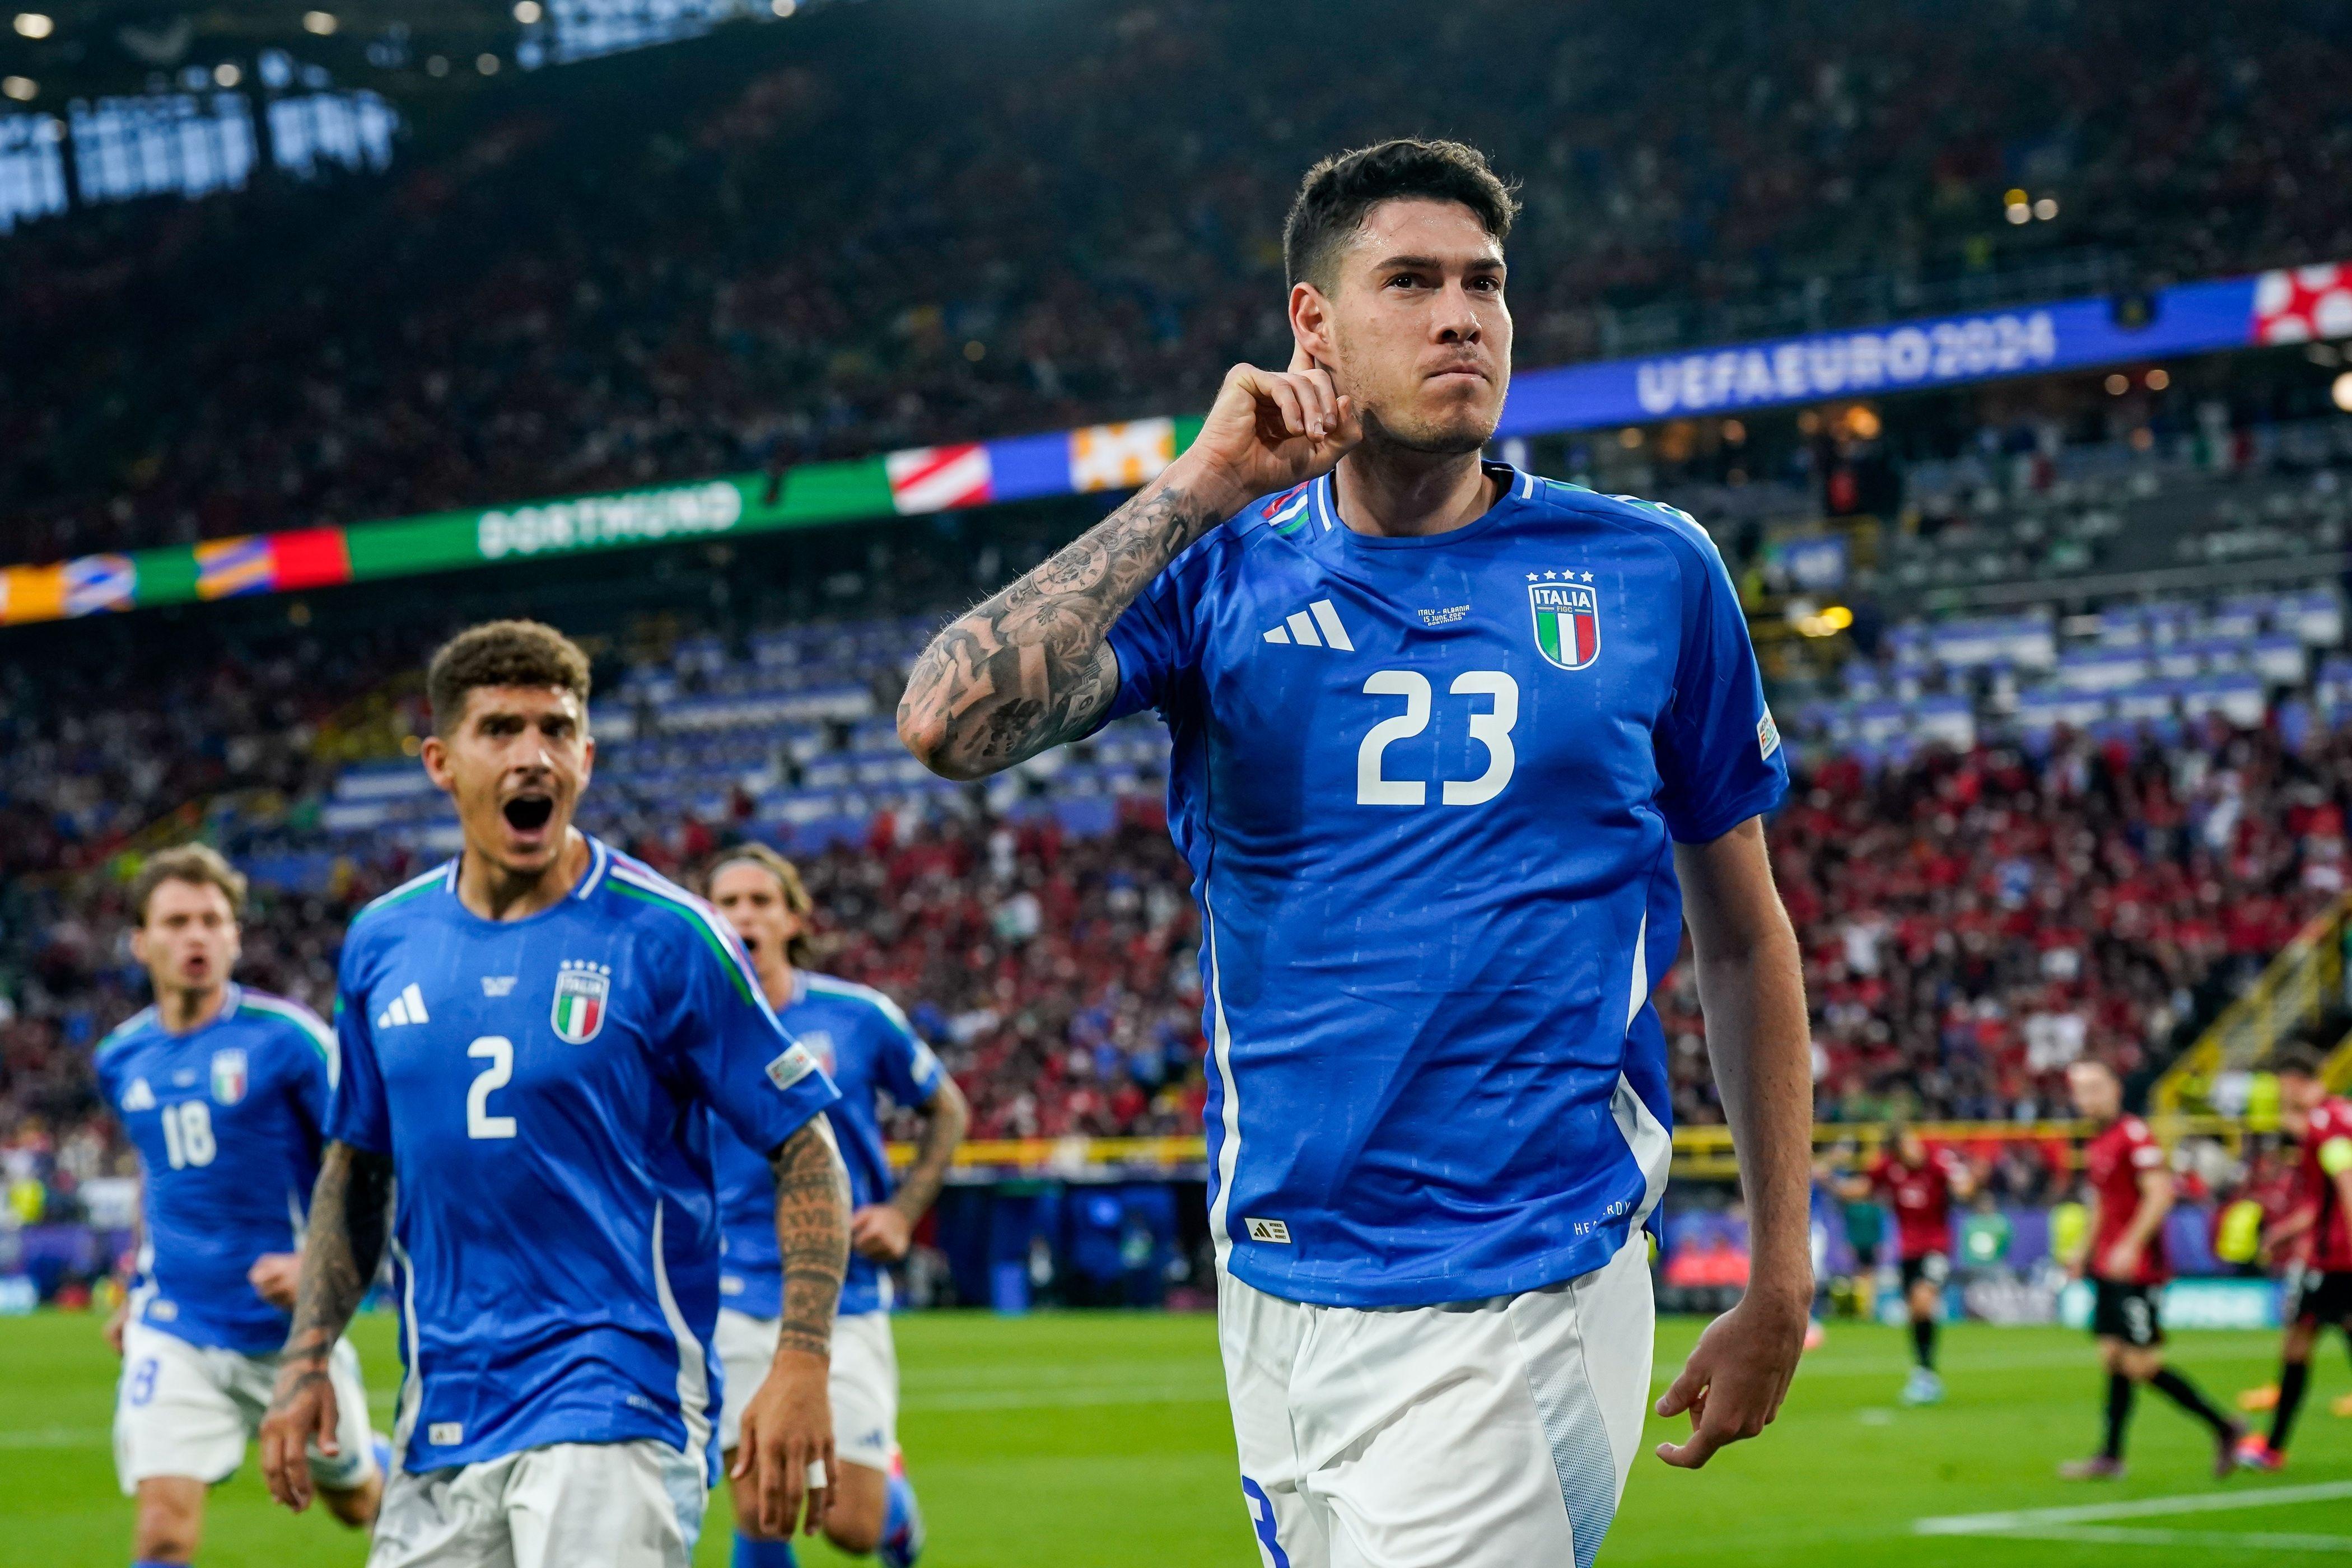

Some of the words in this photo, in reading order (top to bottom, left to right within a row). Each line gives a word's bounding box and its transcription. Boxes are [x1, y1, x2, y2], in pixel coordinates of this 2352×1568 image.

[478, 481, 743, 559] DORTMUND
[1427, 617, 1463, 626] DORTMUND
[1443, 604, 1470, 614] ALBANIA
[1534, 589, 1592, 608] ITALIA
[1356, 670, 1519, 806] 23
[466, 1035, 517, 1140] 2
[161, 1099, 217, 1170] 18
[1574, 1201, 1631, 1235] HE.RDY
